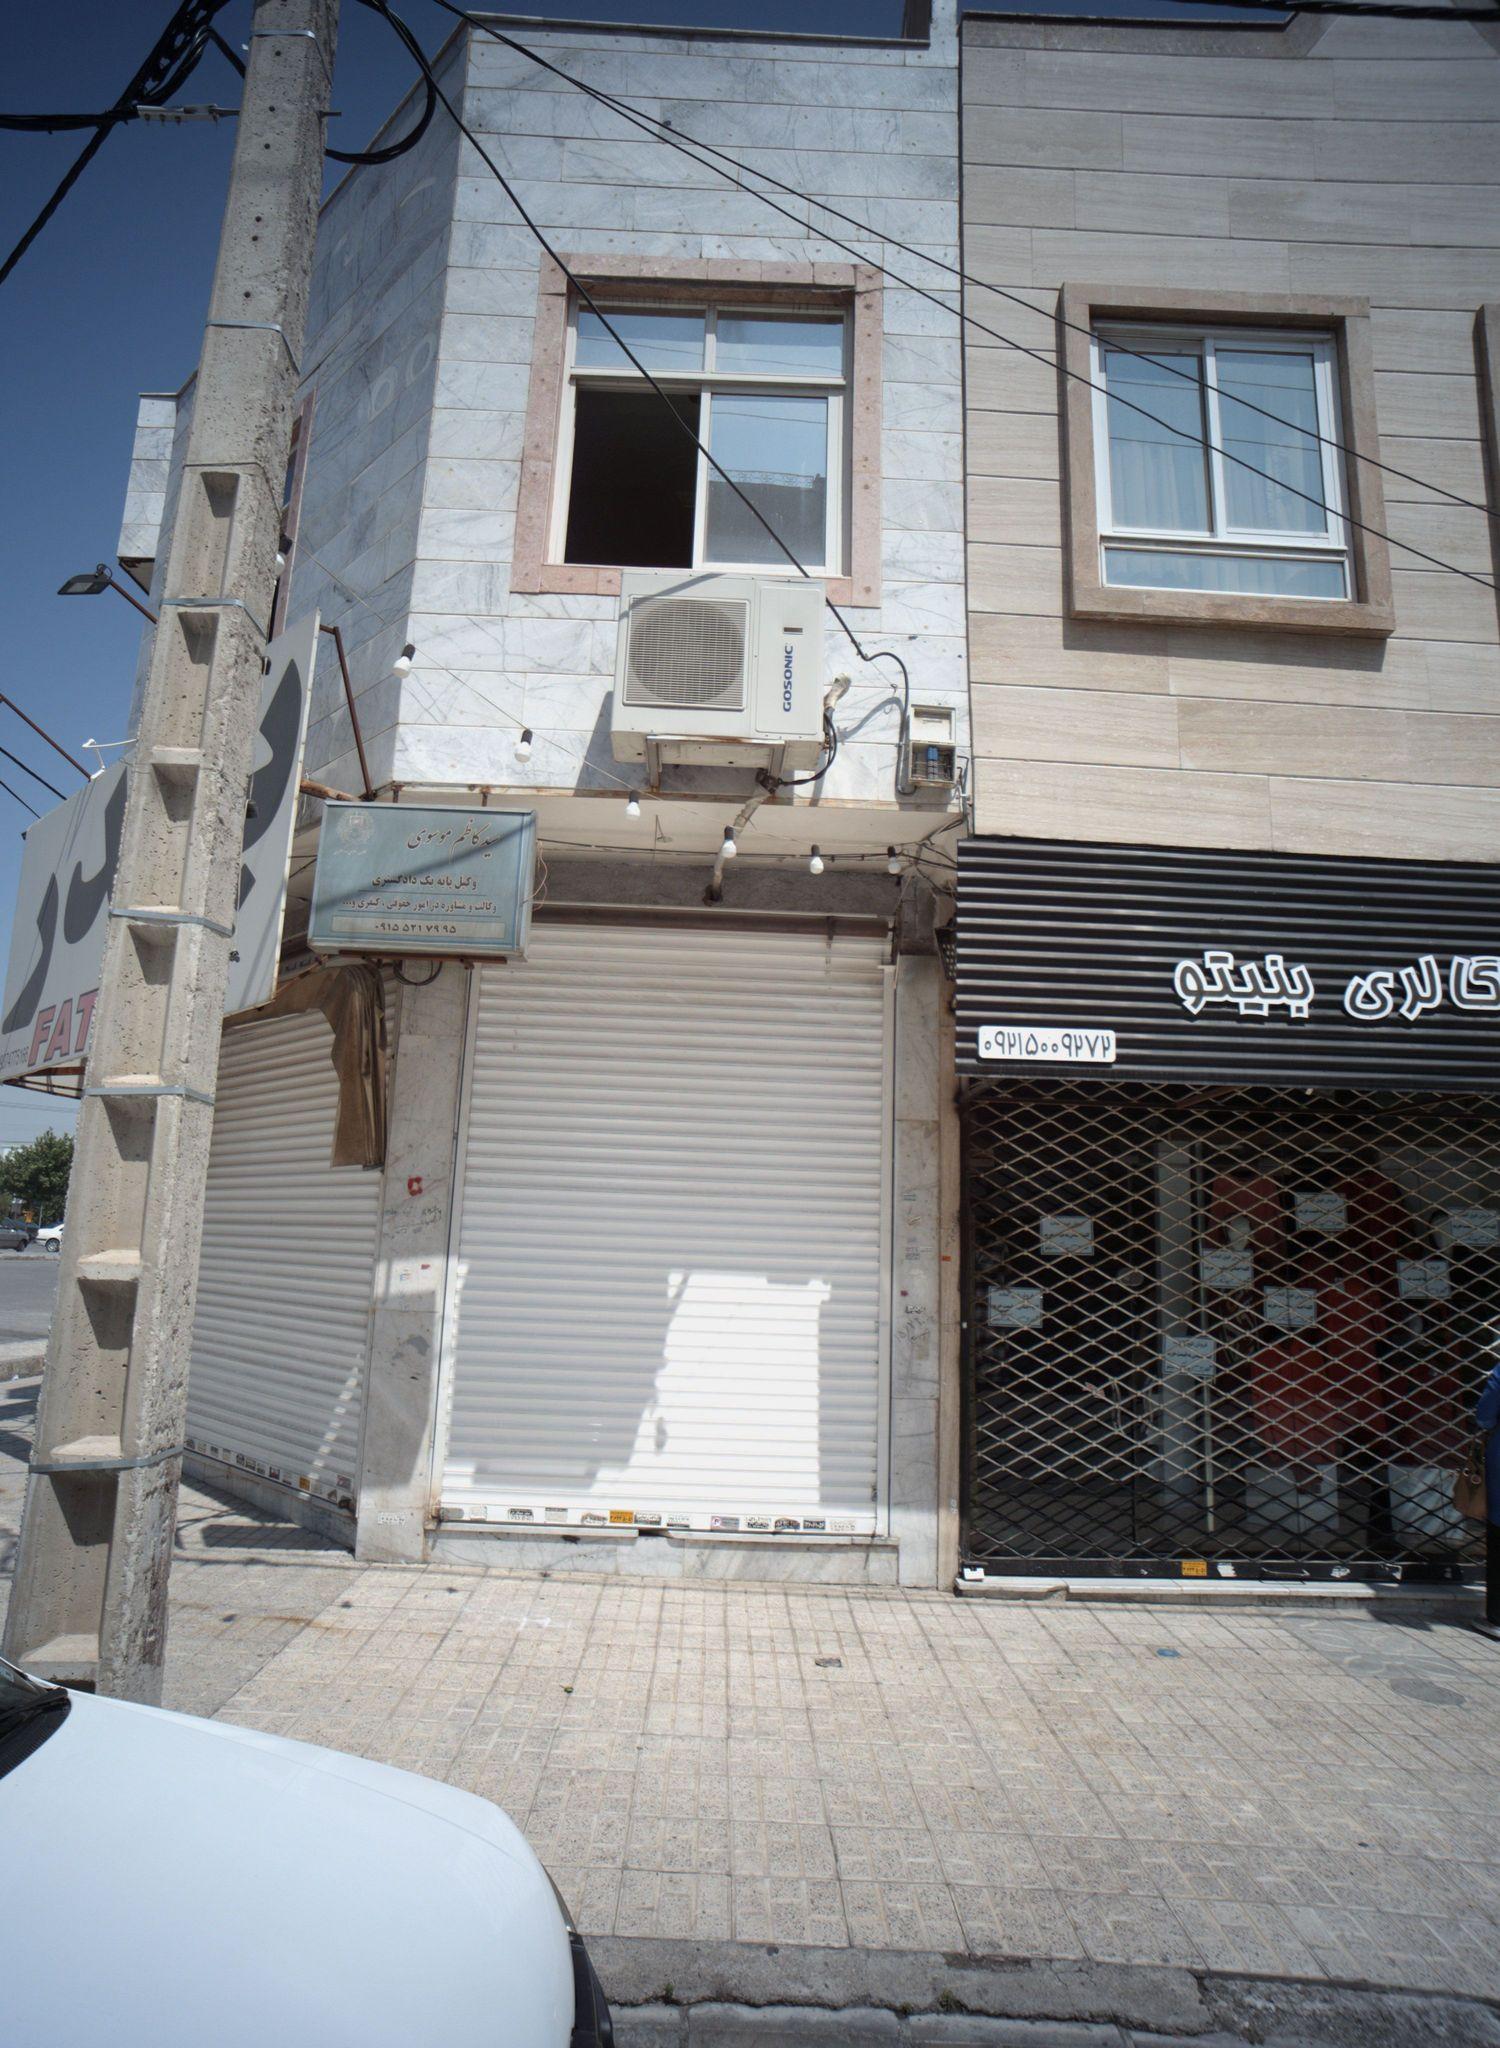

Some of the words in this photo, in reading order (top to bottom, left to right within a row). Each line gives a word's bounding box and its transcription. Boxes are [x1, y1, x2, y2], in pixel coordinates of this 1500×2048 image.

[783, 645, 793, 712] GOSONIC
[407, 828, 452, 849] موسوی
[372, 875, 417, 888] دادگستری
[454, 876, 477, 890] وکیل
[413, 899, 429, 911] امور
[475, 901, 497, 914] وکالت
[1174, 951, 1314, 1018] بنیتو
